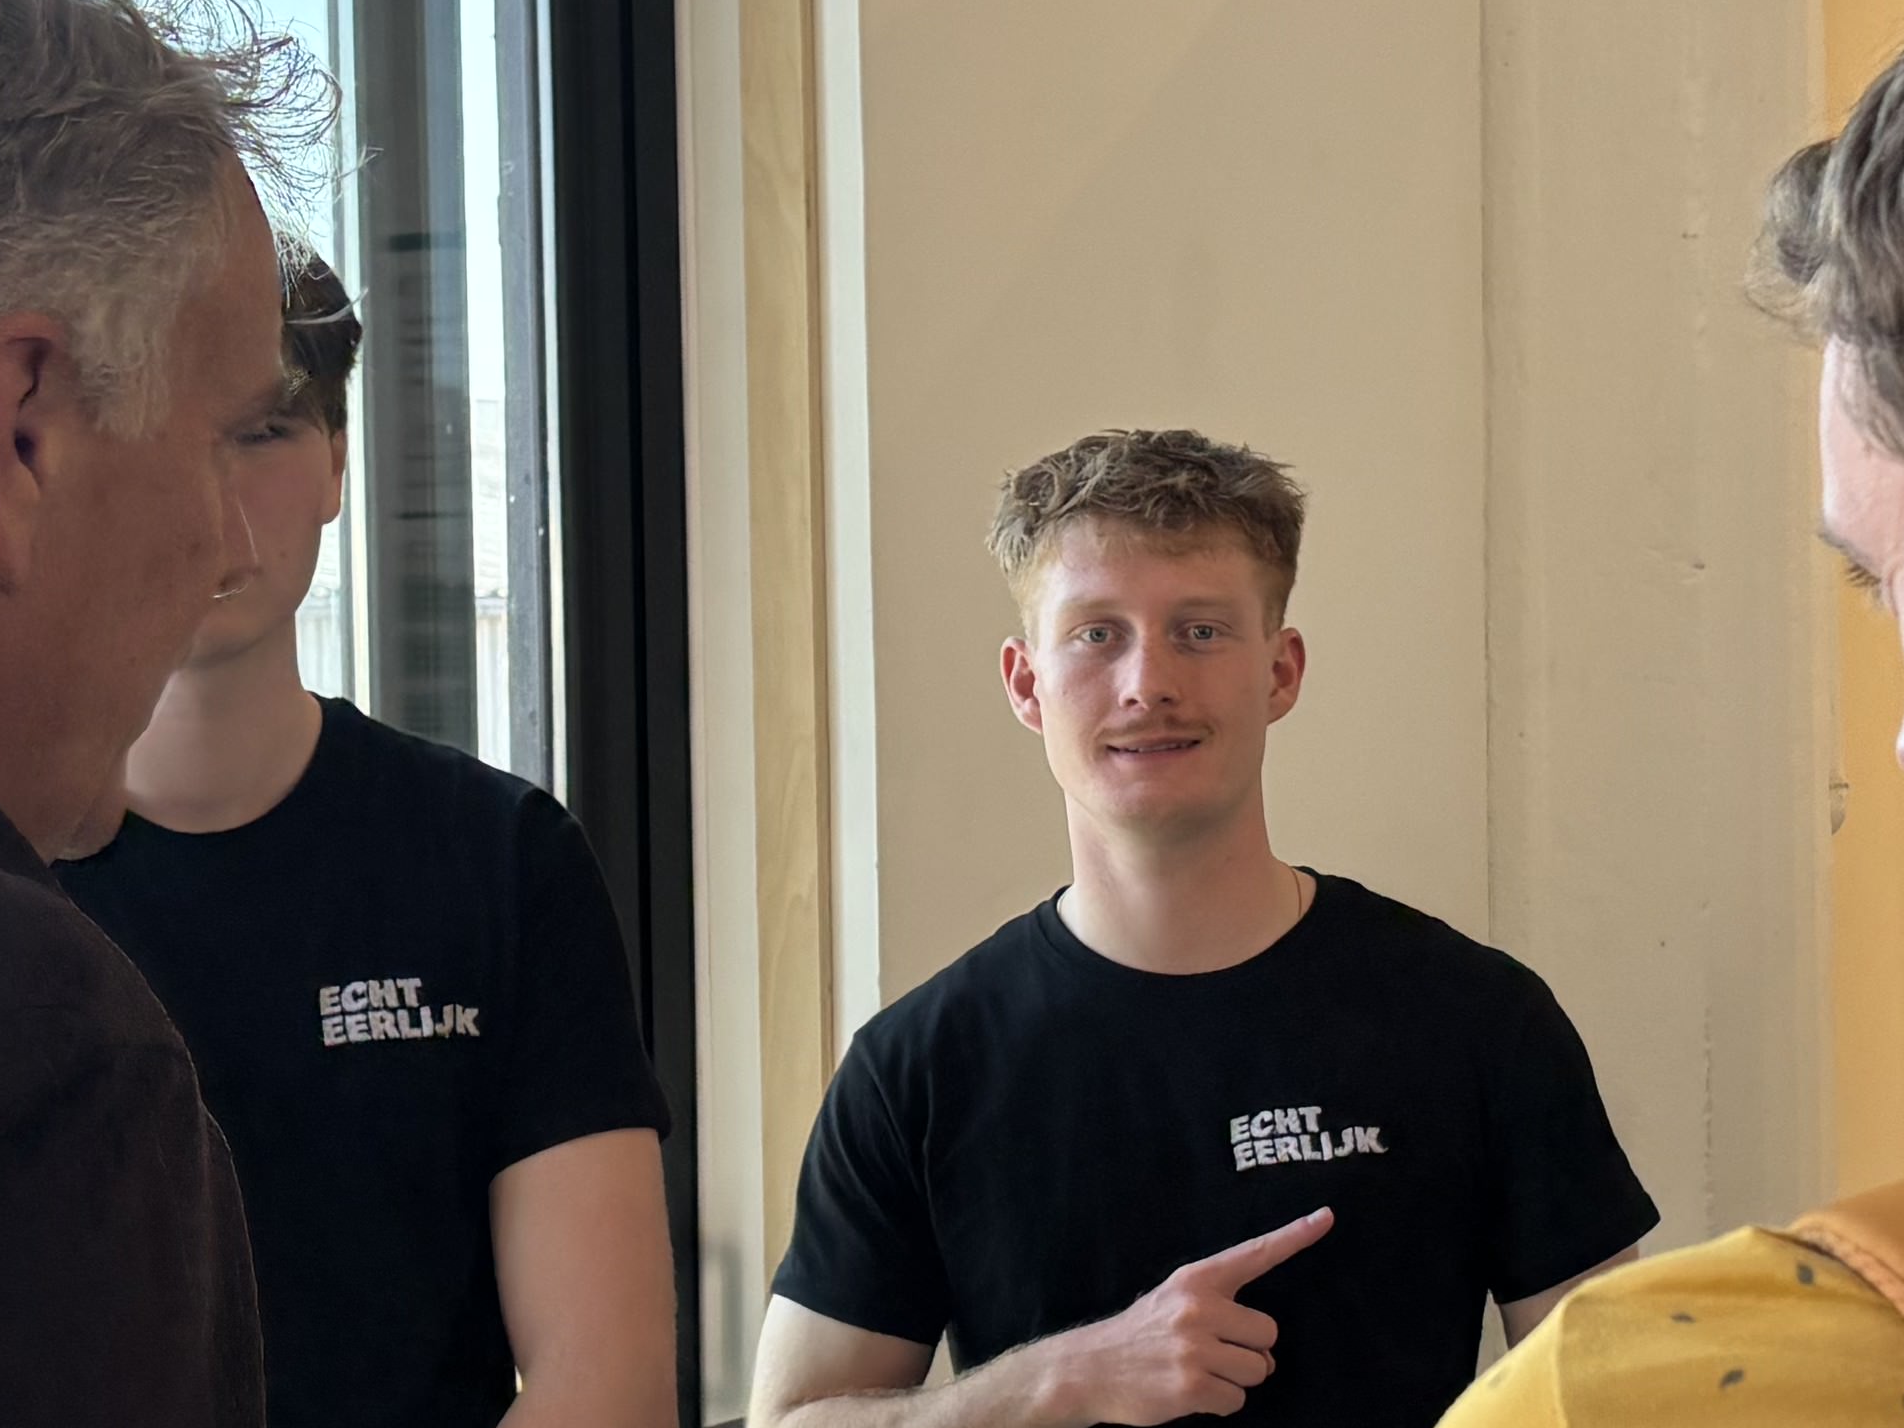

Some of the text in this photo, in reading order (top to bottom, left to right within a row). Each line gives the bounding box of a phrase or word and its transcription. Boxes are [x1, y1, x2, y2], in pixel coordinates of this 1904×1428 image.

[319, 977, 422, 1016] ECHT
[321, 1003, 481, 1047] EERLIJK
[1229, 1105, 1322, 1145] ECHT
[1232, 1126, 1389, 1172] EERLIJK
